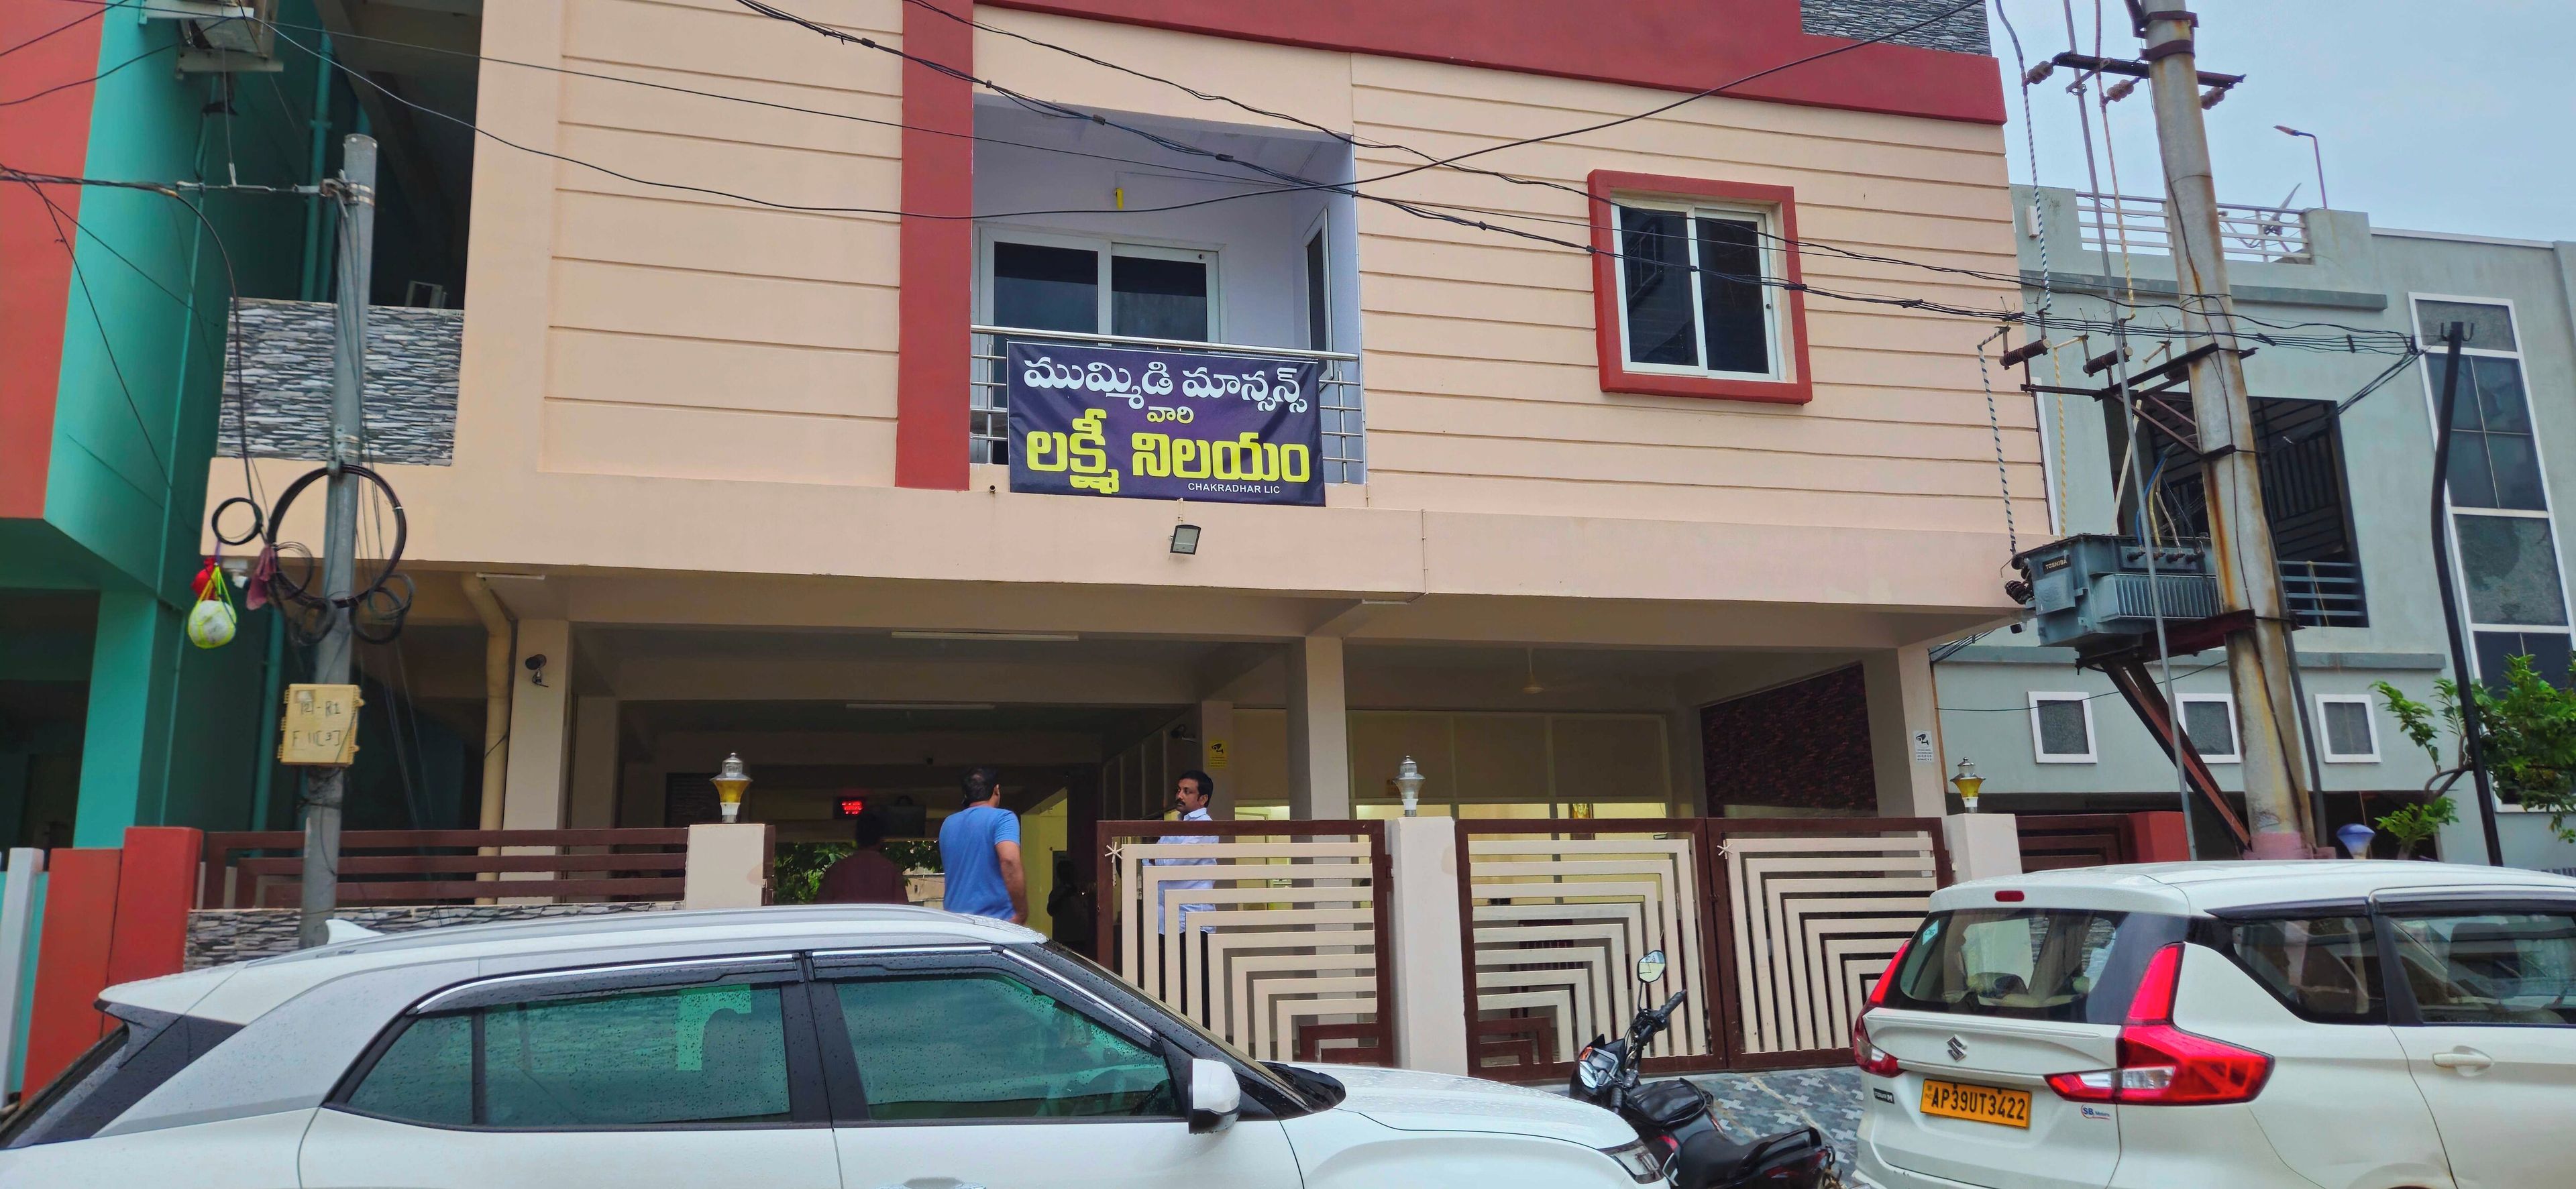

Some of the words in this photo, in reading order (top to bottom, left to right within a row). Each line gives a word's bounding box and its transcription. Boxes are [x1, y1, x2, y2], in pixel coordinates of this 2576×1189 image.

[1024, 356, 1174, 410] ముమ్మిడి
[1146, 406, 1195, 424] వారి
[1026, 408, 1120, 494] లక్ష్మీ
[1131, 431, 1311, 484] నిలయం
[1187, 482, 1261, 494] CHAKRADHAR
[1264, 486, 1281, 494] LIC
[2045, 559, 2068, 569] TOSHIBA
[1931, 1087, 2026, 1121] AP39UT3422
[2083, 1107, 2094, 1115] SB
